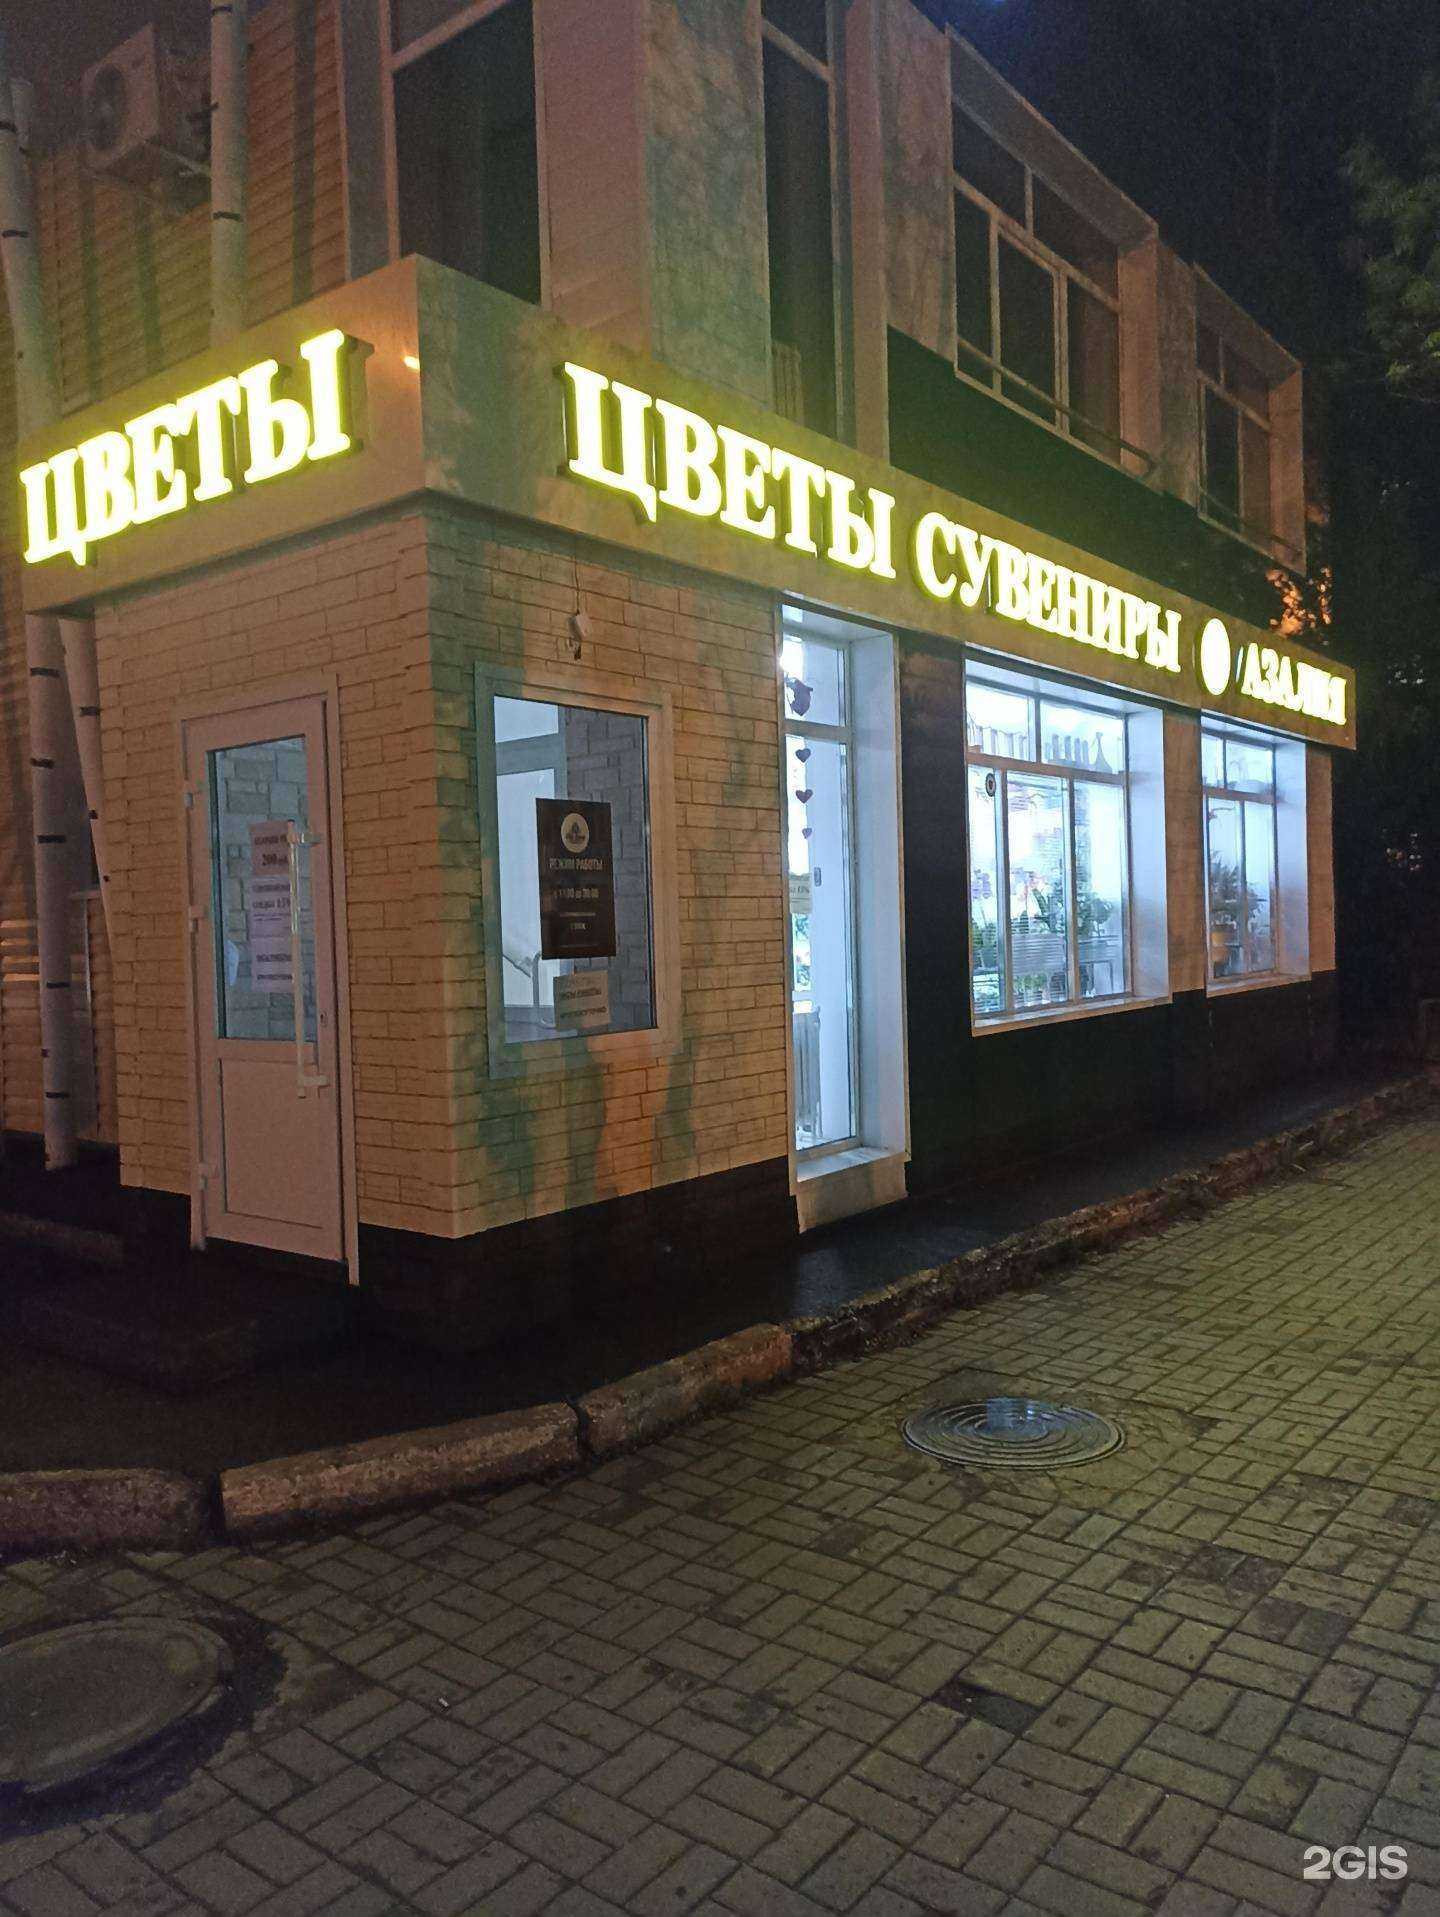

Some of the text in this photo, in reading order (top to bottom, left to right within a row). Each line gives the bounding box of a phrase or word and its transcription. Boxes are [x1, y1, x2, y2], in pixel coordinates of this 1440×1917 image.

[19, 328, 351, 566] ЦВЕТЫ
[564, 361, 1182, 673] ЦВЕТЫ СУВЕНИРЫ
